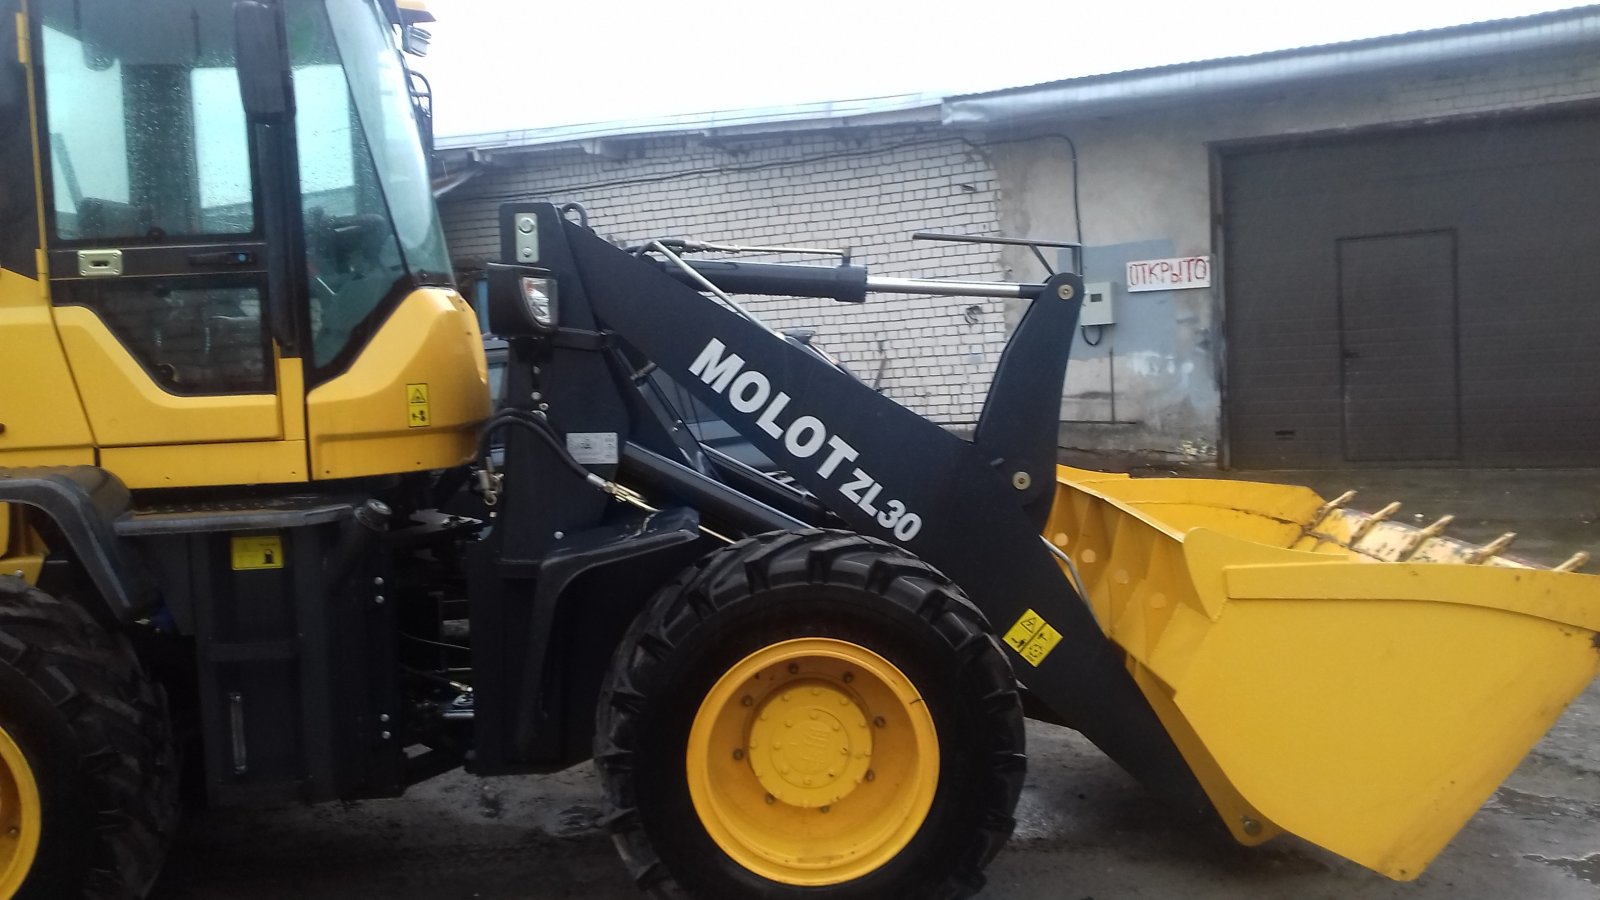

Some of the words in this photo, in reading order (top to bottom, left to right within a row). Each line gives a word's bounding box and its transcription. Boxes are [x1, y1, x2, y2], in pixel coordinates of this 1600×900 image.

[1129, 258, 1207, 286] ОТКРЫТО
[688, 337, 860, 480] MOLOT
[838, 467, 922, 542] ZL30
